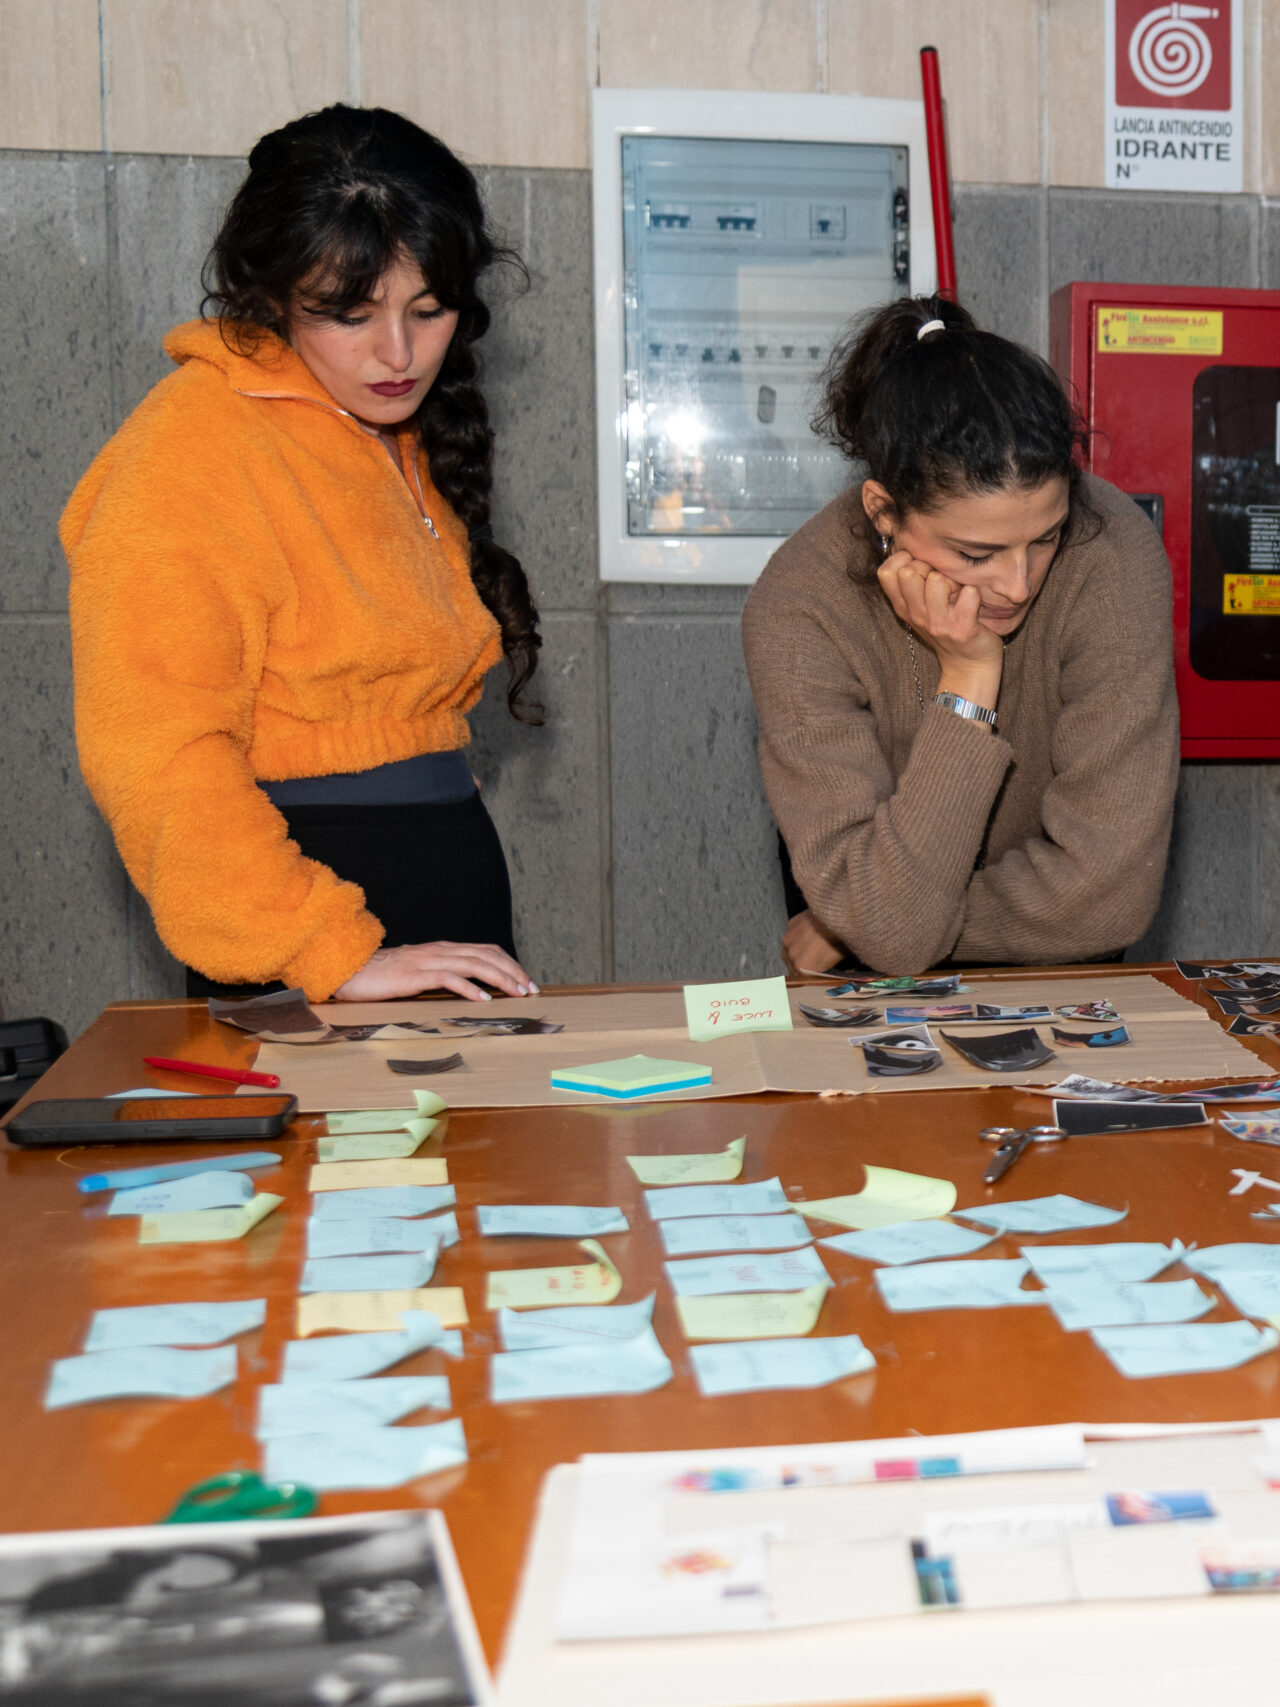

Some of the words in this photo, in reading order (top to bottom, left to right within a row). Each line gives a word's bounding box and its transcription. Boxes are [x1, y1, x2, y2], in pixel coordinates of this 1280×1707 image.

[1114, 117, 1155, 134] LANCIA
[1157, 119, 1232, 137] ANTINCENDIO
[1116, 138, 1231, 162] IDRANTE
[710, 997, 751, 1008] BUIO
[732, 1010, 773, 1022] LUCE
